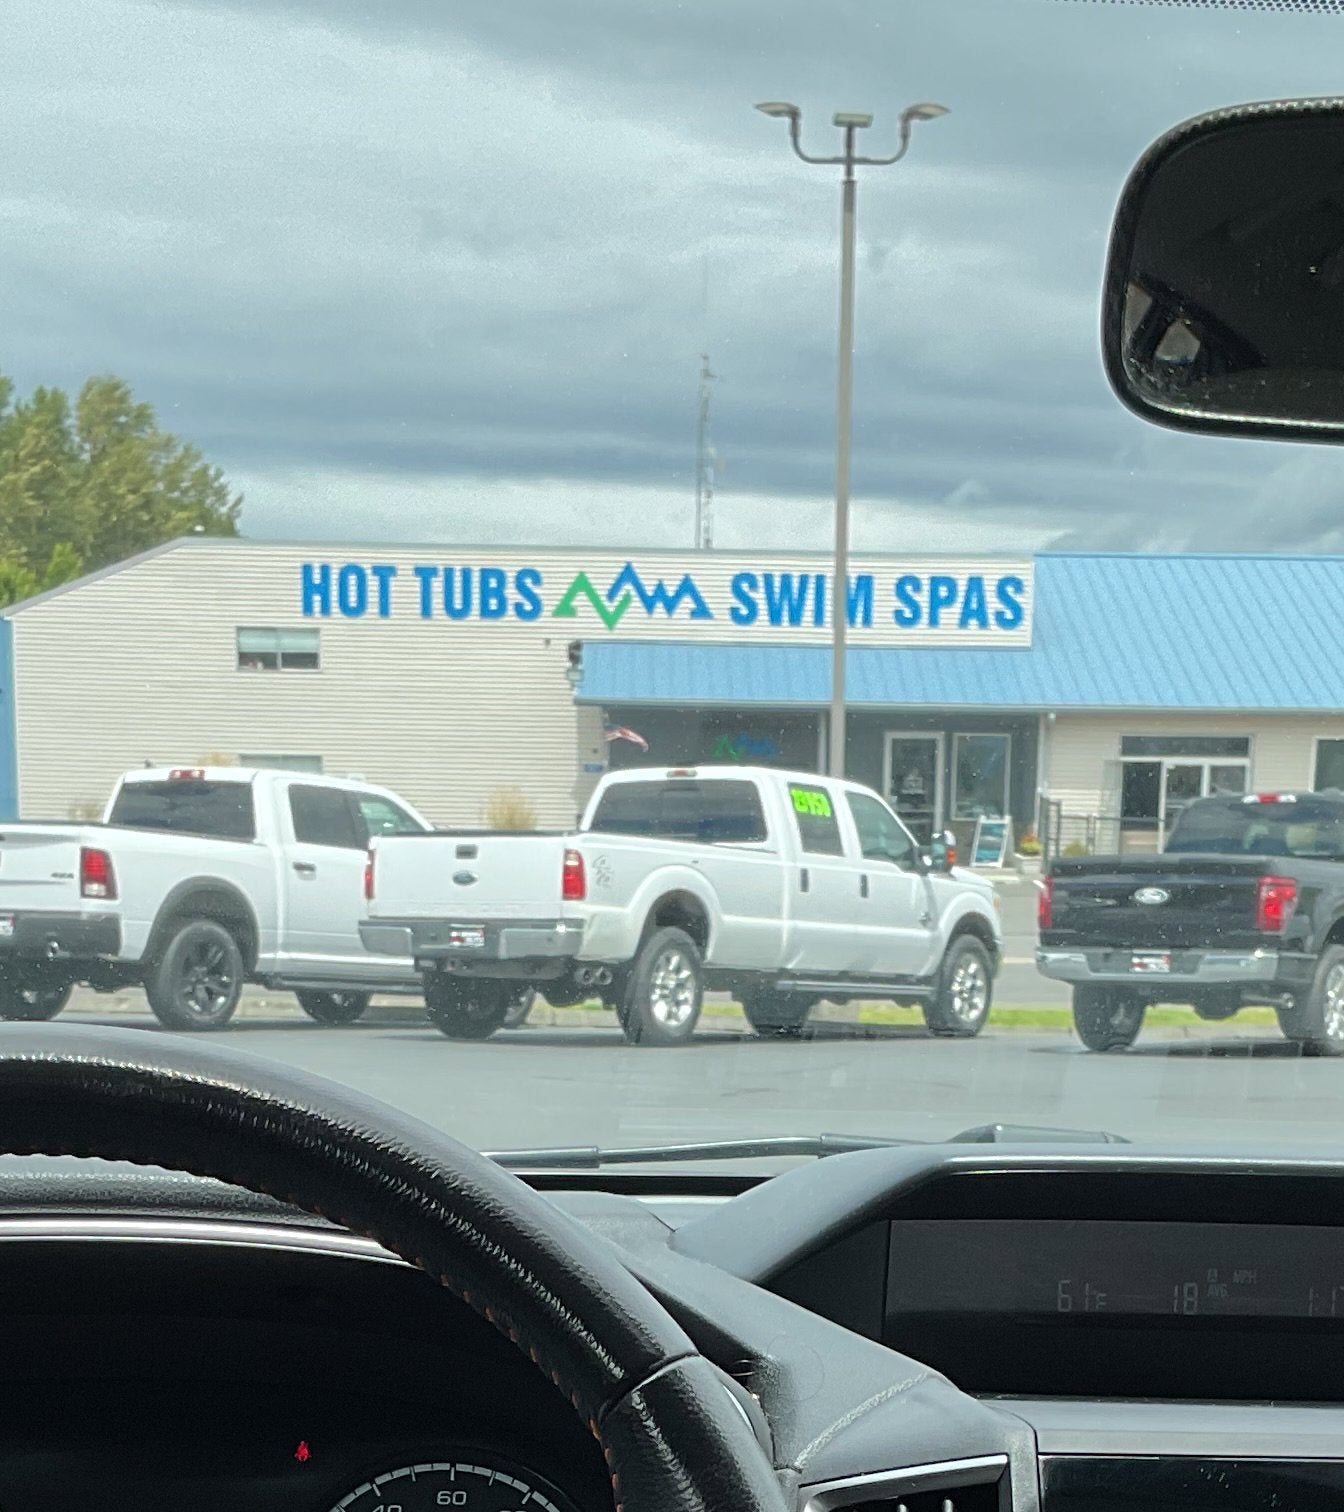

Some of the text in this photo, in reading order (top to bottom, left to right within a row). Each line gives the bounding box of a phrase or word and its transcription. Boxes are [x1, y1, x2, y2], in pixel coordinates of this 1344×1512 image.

[301, 563, 543, 621] HOT TUBS
[729, 572, 1025, 630] SWIM SPAS
[436, 1490, 467, 1505] 60
